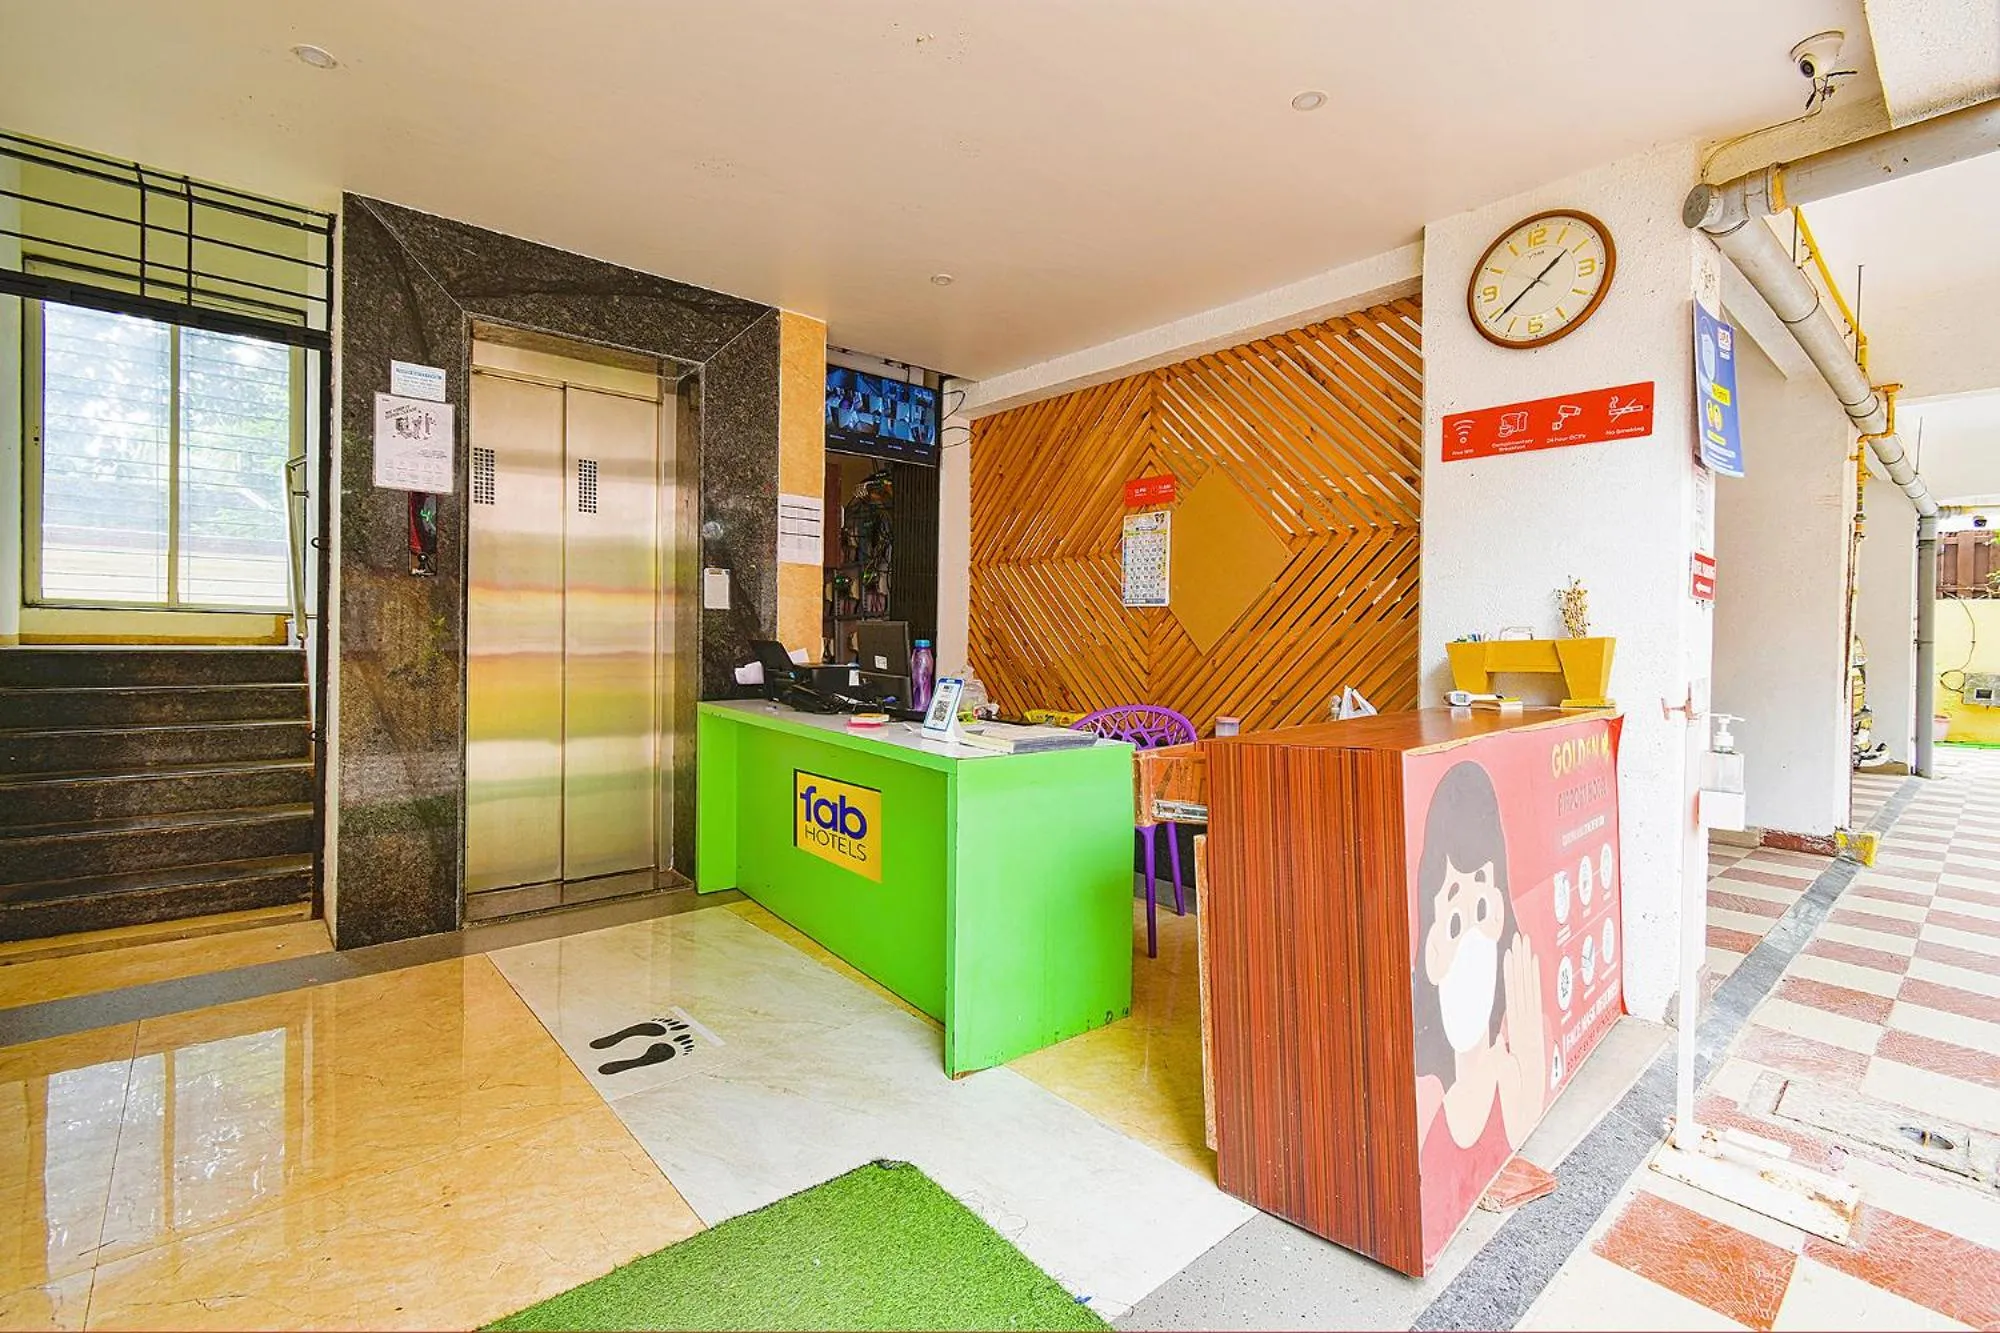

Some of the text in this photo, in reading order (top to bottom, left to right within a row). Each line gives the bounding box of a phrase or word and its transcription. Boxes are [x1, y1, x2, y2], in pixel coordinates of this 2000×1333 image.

[1527, 227, 1548, 248] 12
[1578, 257, 1597, 278] 3
[1482, 285, 1499, 304] 9
[1527, 315, 1544, 334] 6
[799, 785, 868, 840] fab
[804, 824, 867, 862] HOTELS
